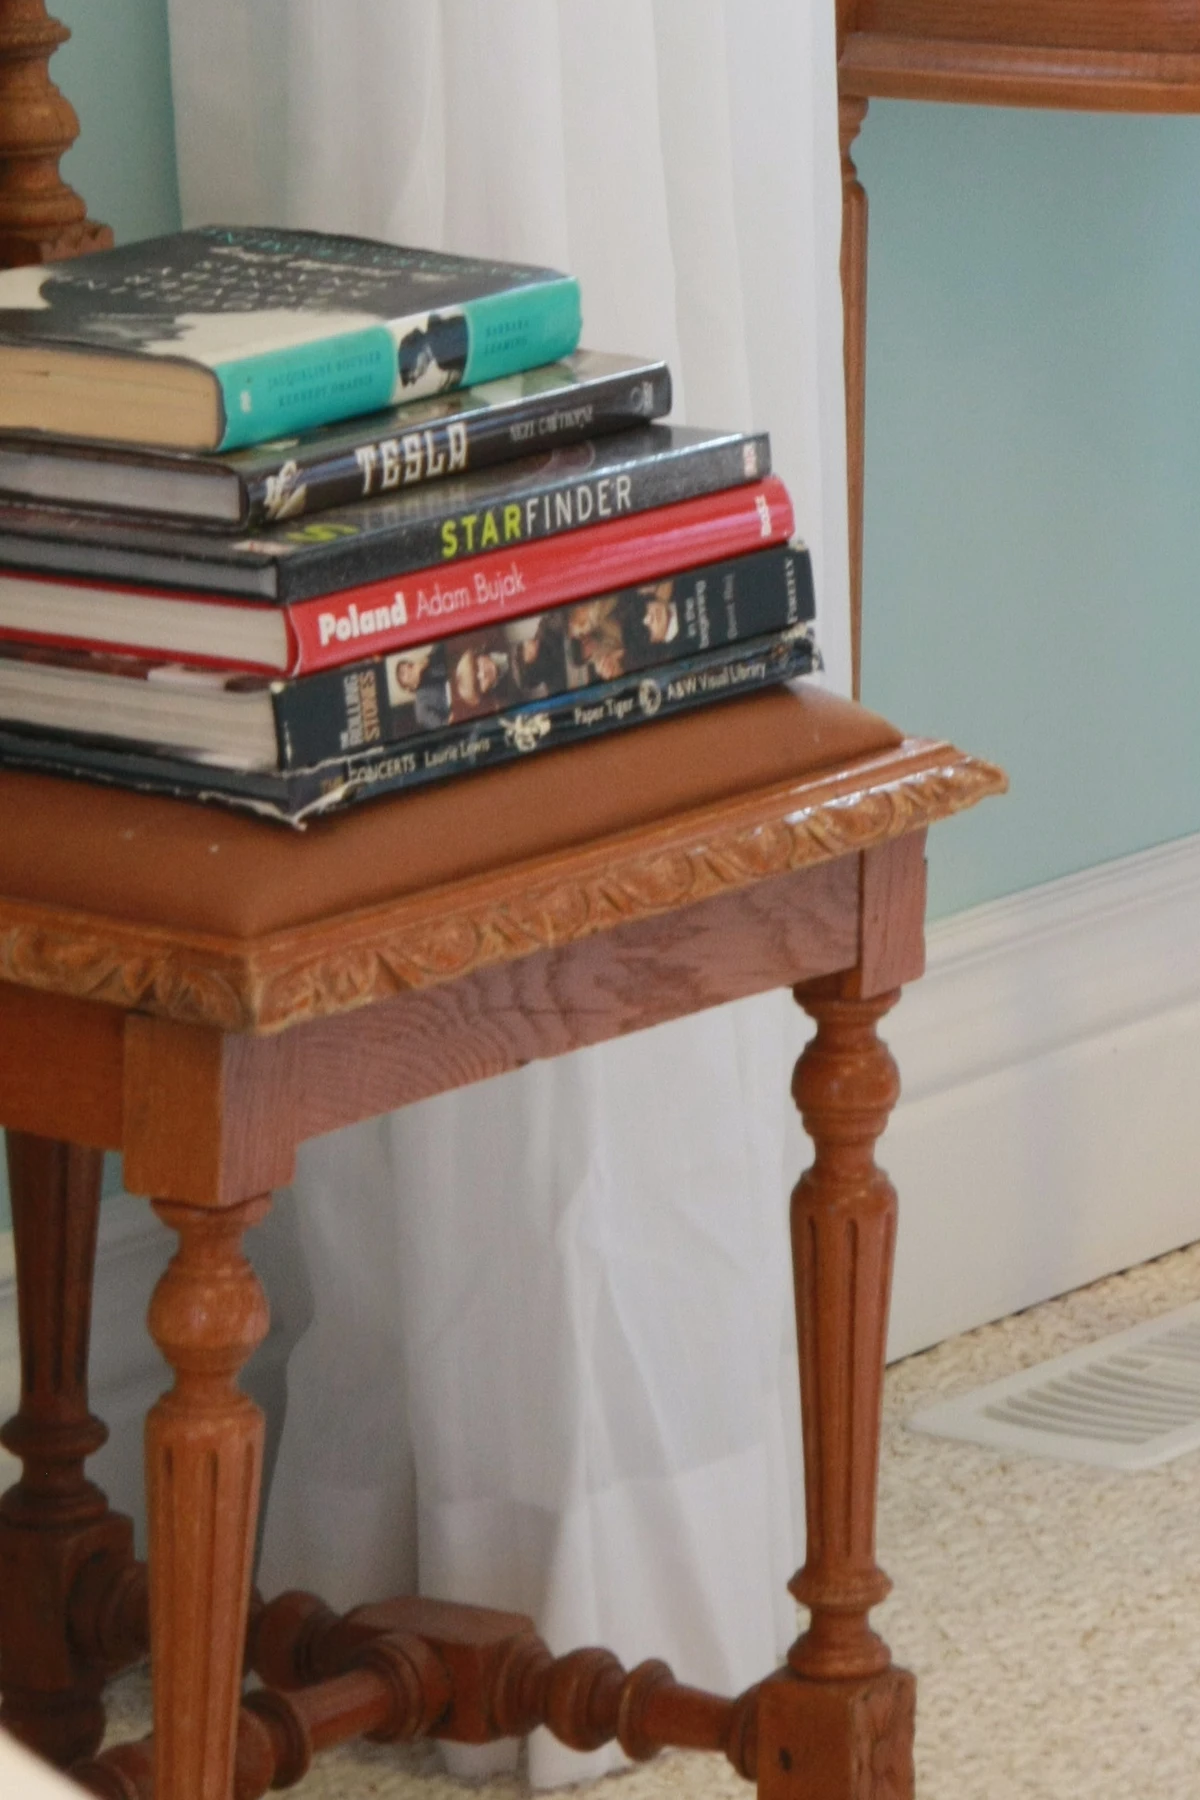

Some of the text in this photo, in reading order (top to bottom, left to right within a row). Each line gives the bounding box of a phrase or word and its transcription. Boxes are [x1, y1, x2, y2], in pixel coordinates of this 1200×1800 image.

[354, 422, 469, 495] TESLA
[441, 475, 632, 559] STARFINDER
[318, 562, 527, 647] Poland Adam Bujak
[343, 674, 364, 747] ROLLING
[359, 669, 381, 742] STONES
[573, 698, 634, 726] Paper Tiger
[699, 669, 730, 692] Visual
[730, 662, 766, 684] Library
[425, 745, 459, 769] Laurie
